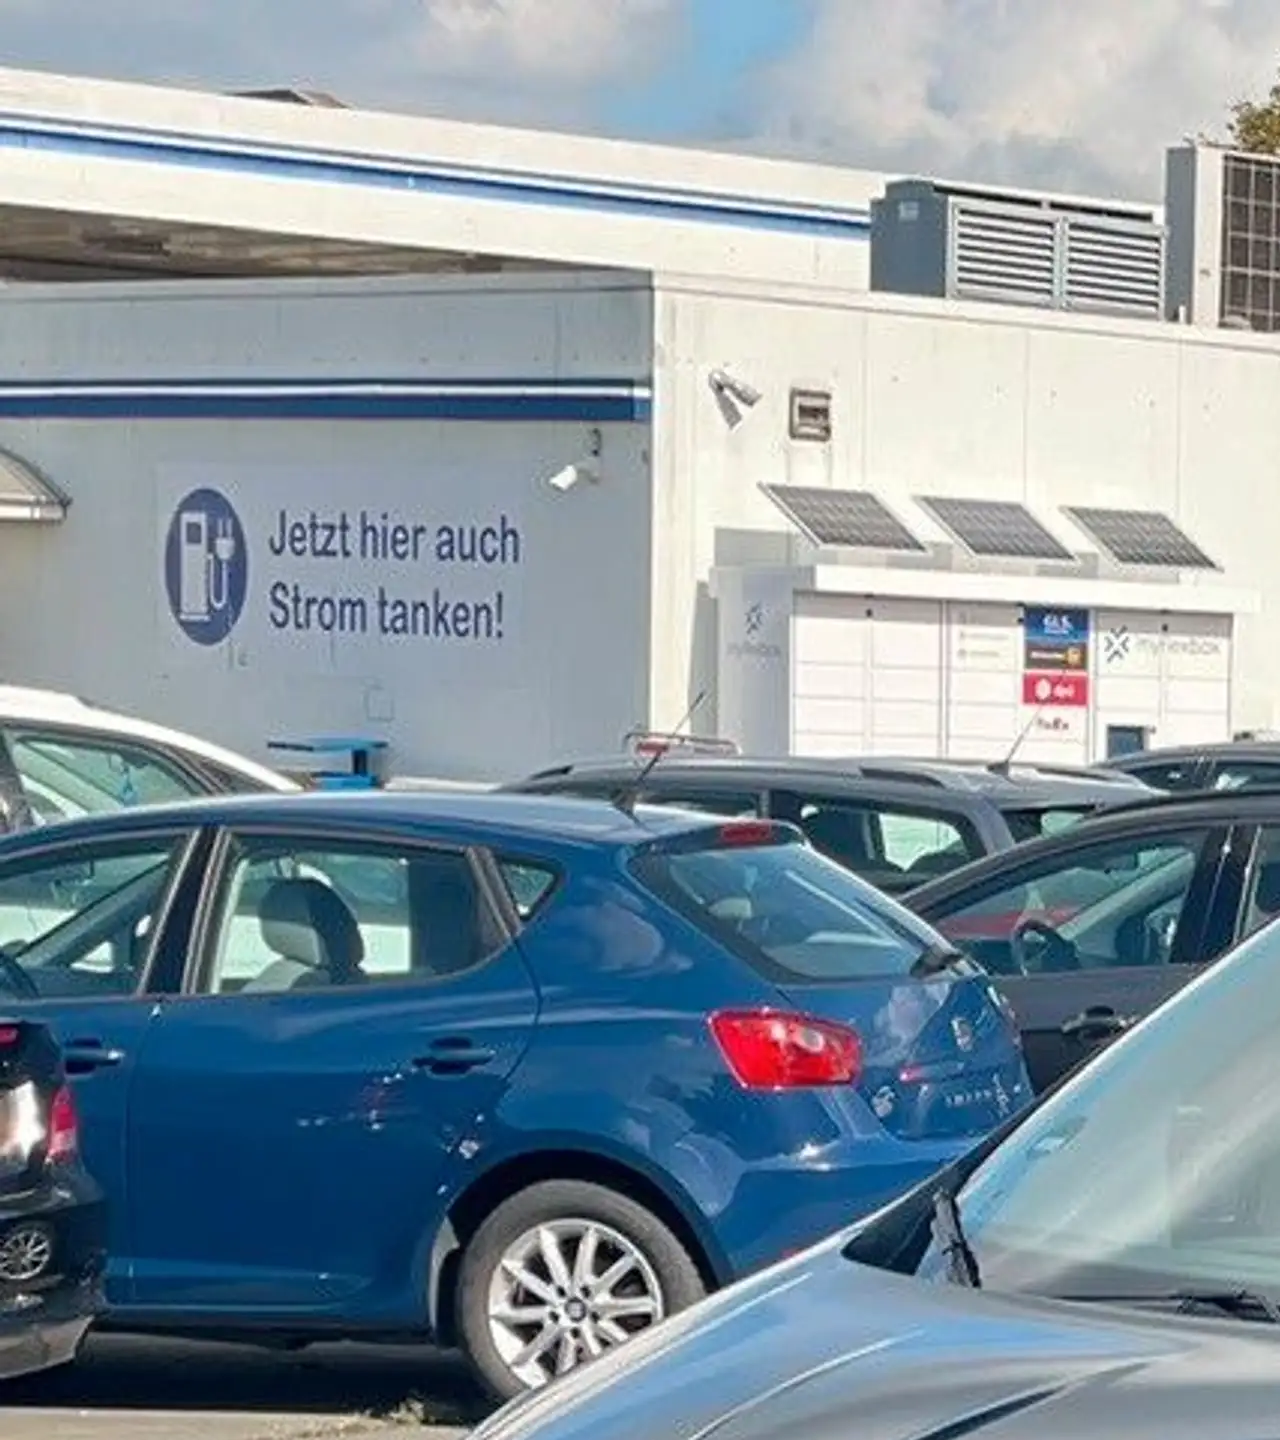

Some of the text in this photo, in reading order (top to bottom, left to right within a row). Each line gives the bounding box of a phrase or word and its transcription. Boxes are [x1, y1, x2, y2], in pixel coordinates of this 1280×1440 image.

[269, 510, 520, 564] Jetzt hier auch
[269, 581, 504, 639] Strom tanken!
